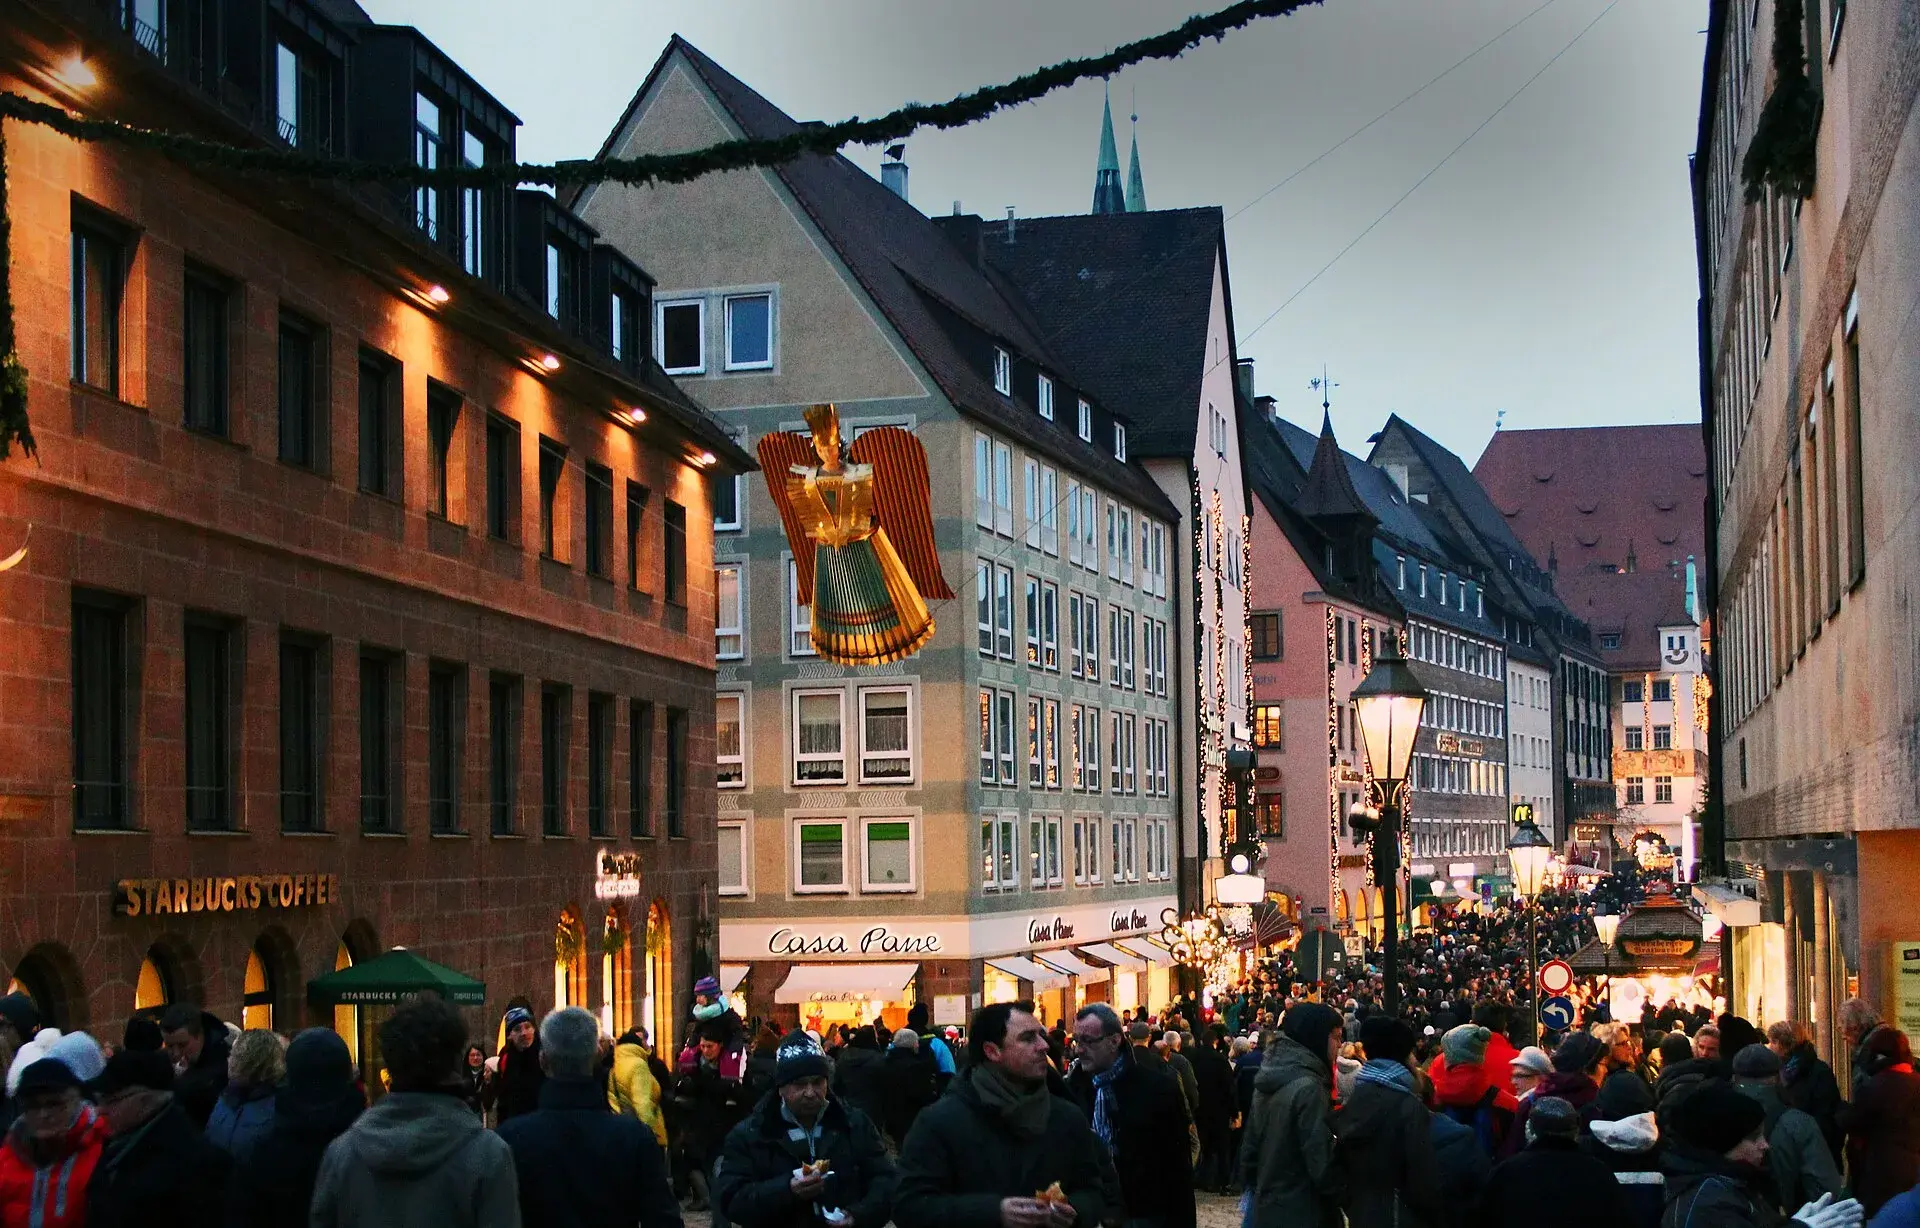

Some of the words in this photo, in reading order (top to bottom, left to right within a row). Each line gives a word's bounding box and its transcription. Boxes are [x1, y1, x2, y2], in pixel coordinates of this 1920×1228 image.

[119, 876, 261, 917] STARBUCKS
[266, 873, 339, 908] COFFEE
[1028, 919, 1051, 944] Casa
[1053, 916, 1075, 941] Pane
[1111, 911, 1129, 932] Casa
[1131, 908, 1148, 930] Pane
[768, 928, 849, 954] Casa
[860, 927, 942, 954] Pane
[341, 991, 397, 1000] STARBUCKS
[809, 991, 837, 1002] Casa
